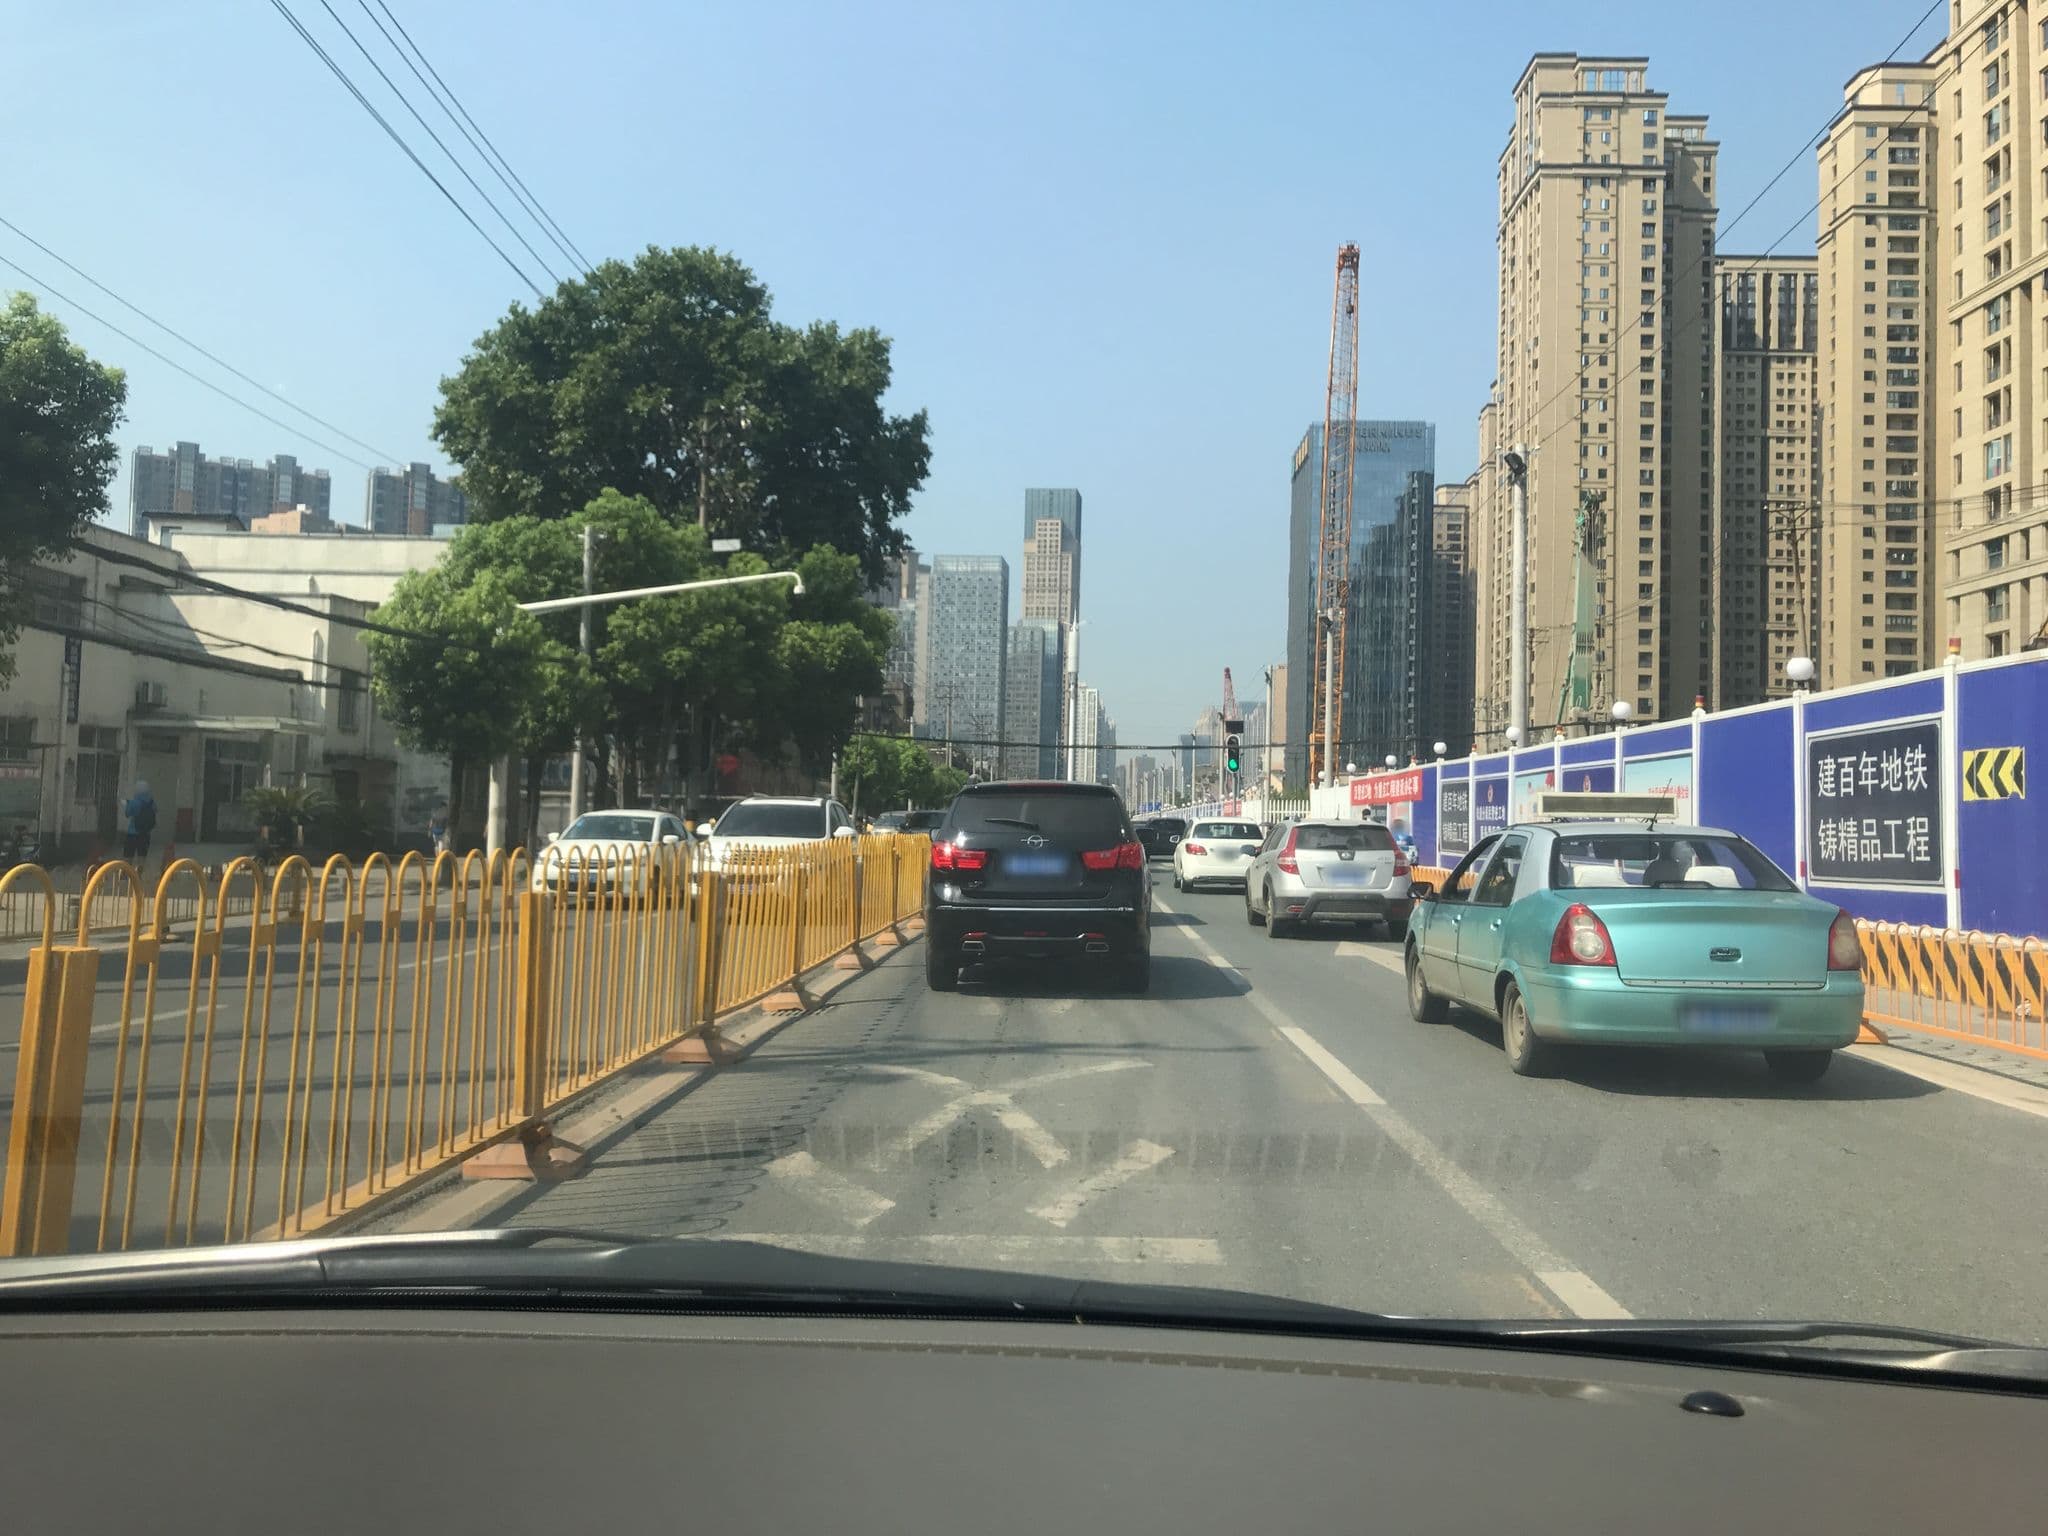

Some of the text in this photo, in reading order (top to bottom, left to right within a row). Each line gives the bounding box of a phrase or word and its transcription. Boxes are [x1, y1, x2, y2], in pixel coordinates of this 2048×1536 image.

[1817, 743, 1928, 798] 建百年地铁
[1443, 790, 1468, 812] 建百年地铁
[1818, 815, 1931, 864] 铸精品工程
